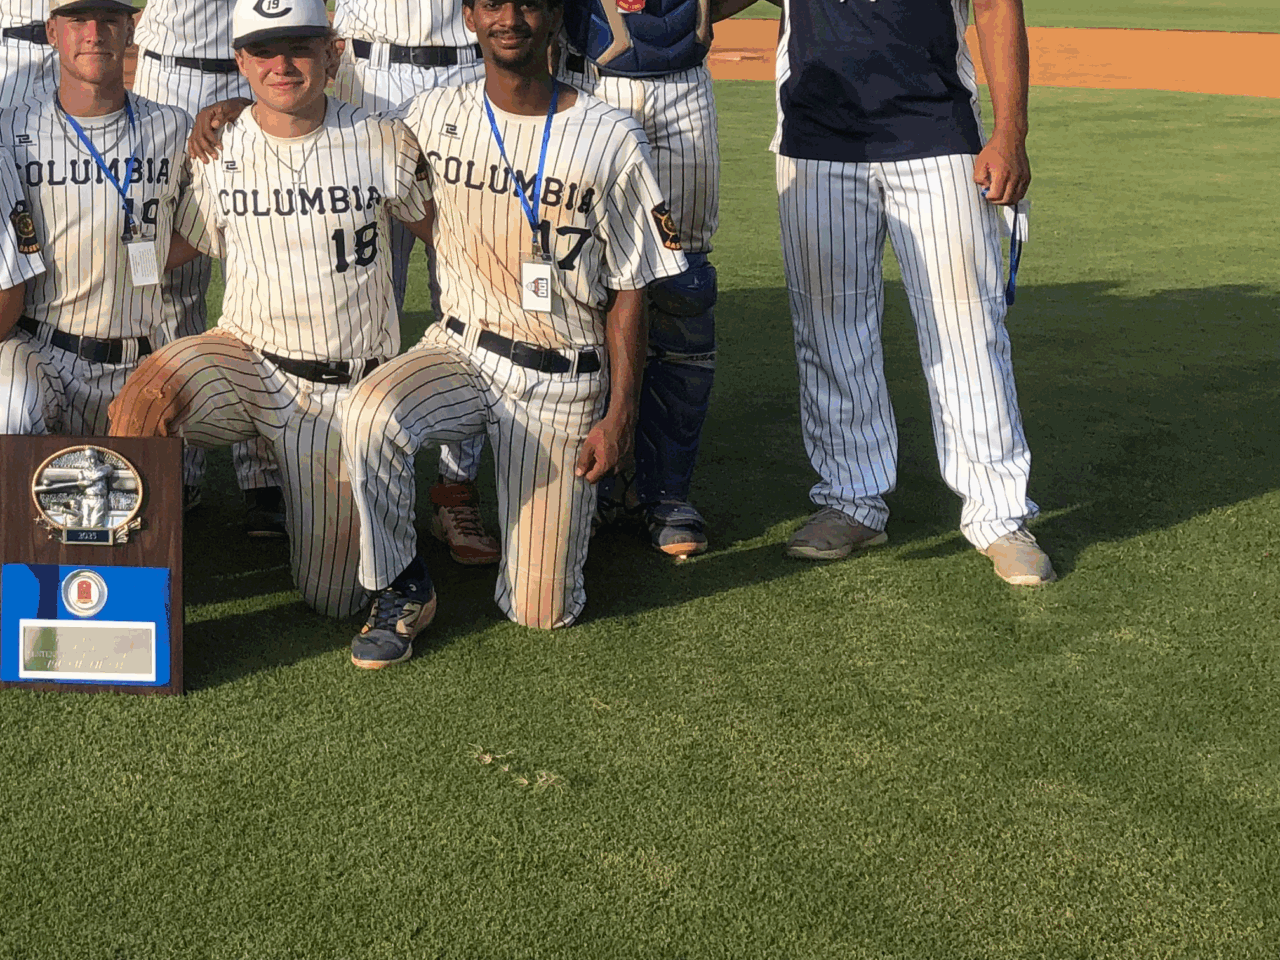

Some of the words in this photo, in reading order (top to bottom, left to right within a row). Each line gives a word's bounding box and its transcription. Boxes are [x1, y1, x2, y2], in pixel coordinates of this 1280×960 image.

[15, 157, 169, 188] OLUMBIA
[426, 150, 595, 215] COLUMBIA
[220, 186, 382, 218] COLUMBIA
[331, 221, 380, 274] 18
[538, 219, 593, 272] 17
